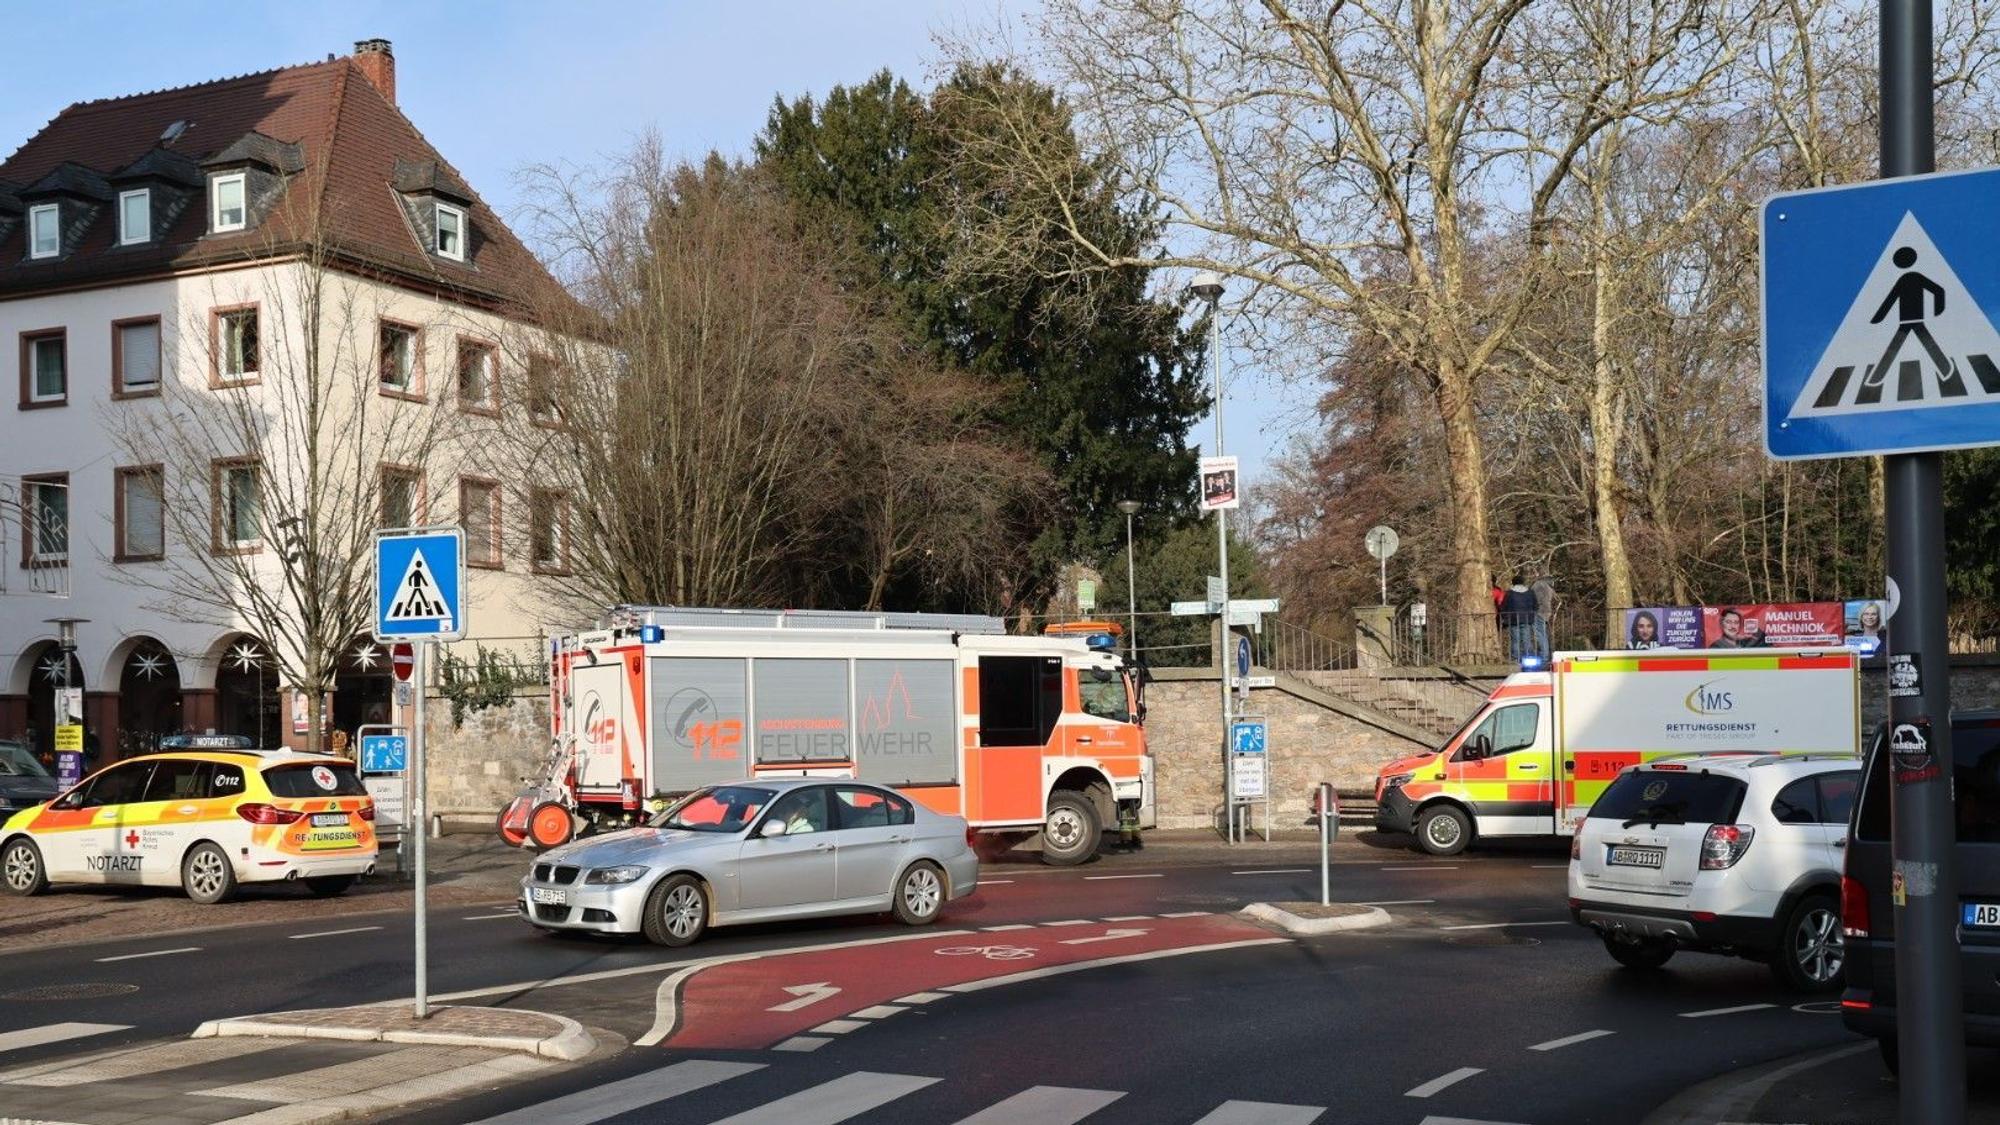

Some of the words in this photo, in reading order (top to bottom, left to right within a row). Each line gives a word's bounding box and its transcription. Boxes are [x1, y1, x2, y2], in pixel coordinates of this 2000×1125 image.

[1765, 611, 1814, 621] MANUEL
[1765, 623, 1825, 633] MICHNIOK
[1666, 723, 1756, 731] RETTUNGSDIENST
[688, 719, 743, 749] 112
[197, 737, 228, 746] NOTARZT
[225, 776, 239, 785] 112
[295, 831, 366, 842] RETTUNGSDIENST
[86, 855, 144, 871] NOTARZT
[1976, 906, 1999, 924] AB
